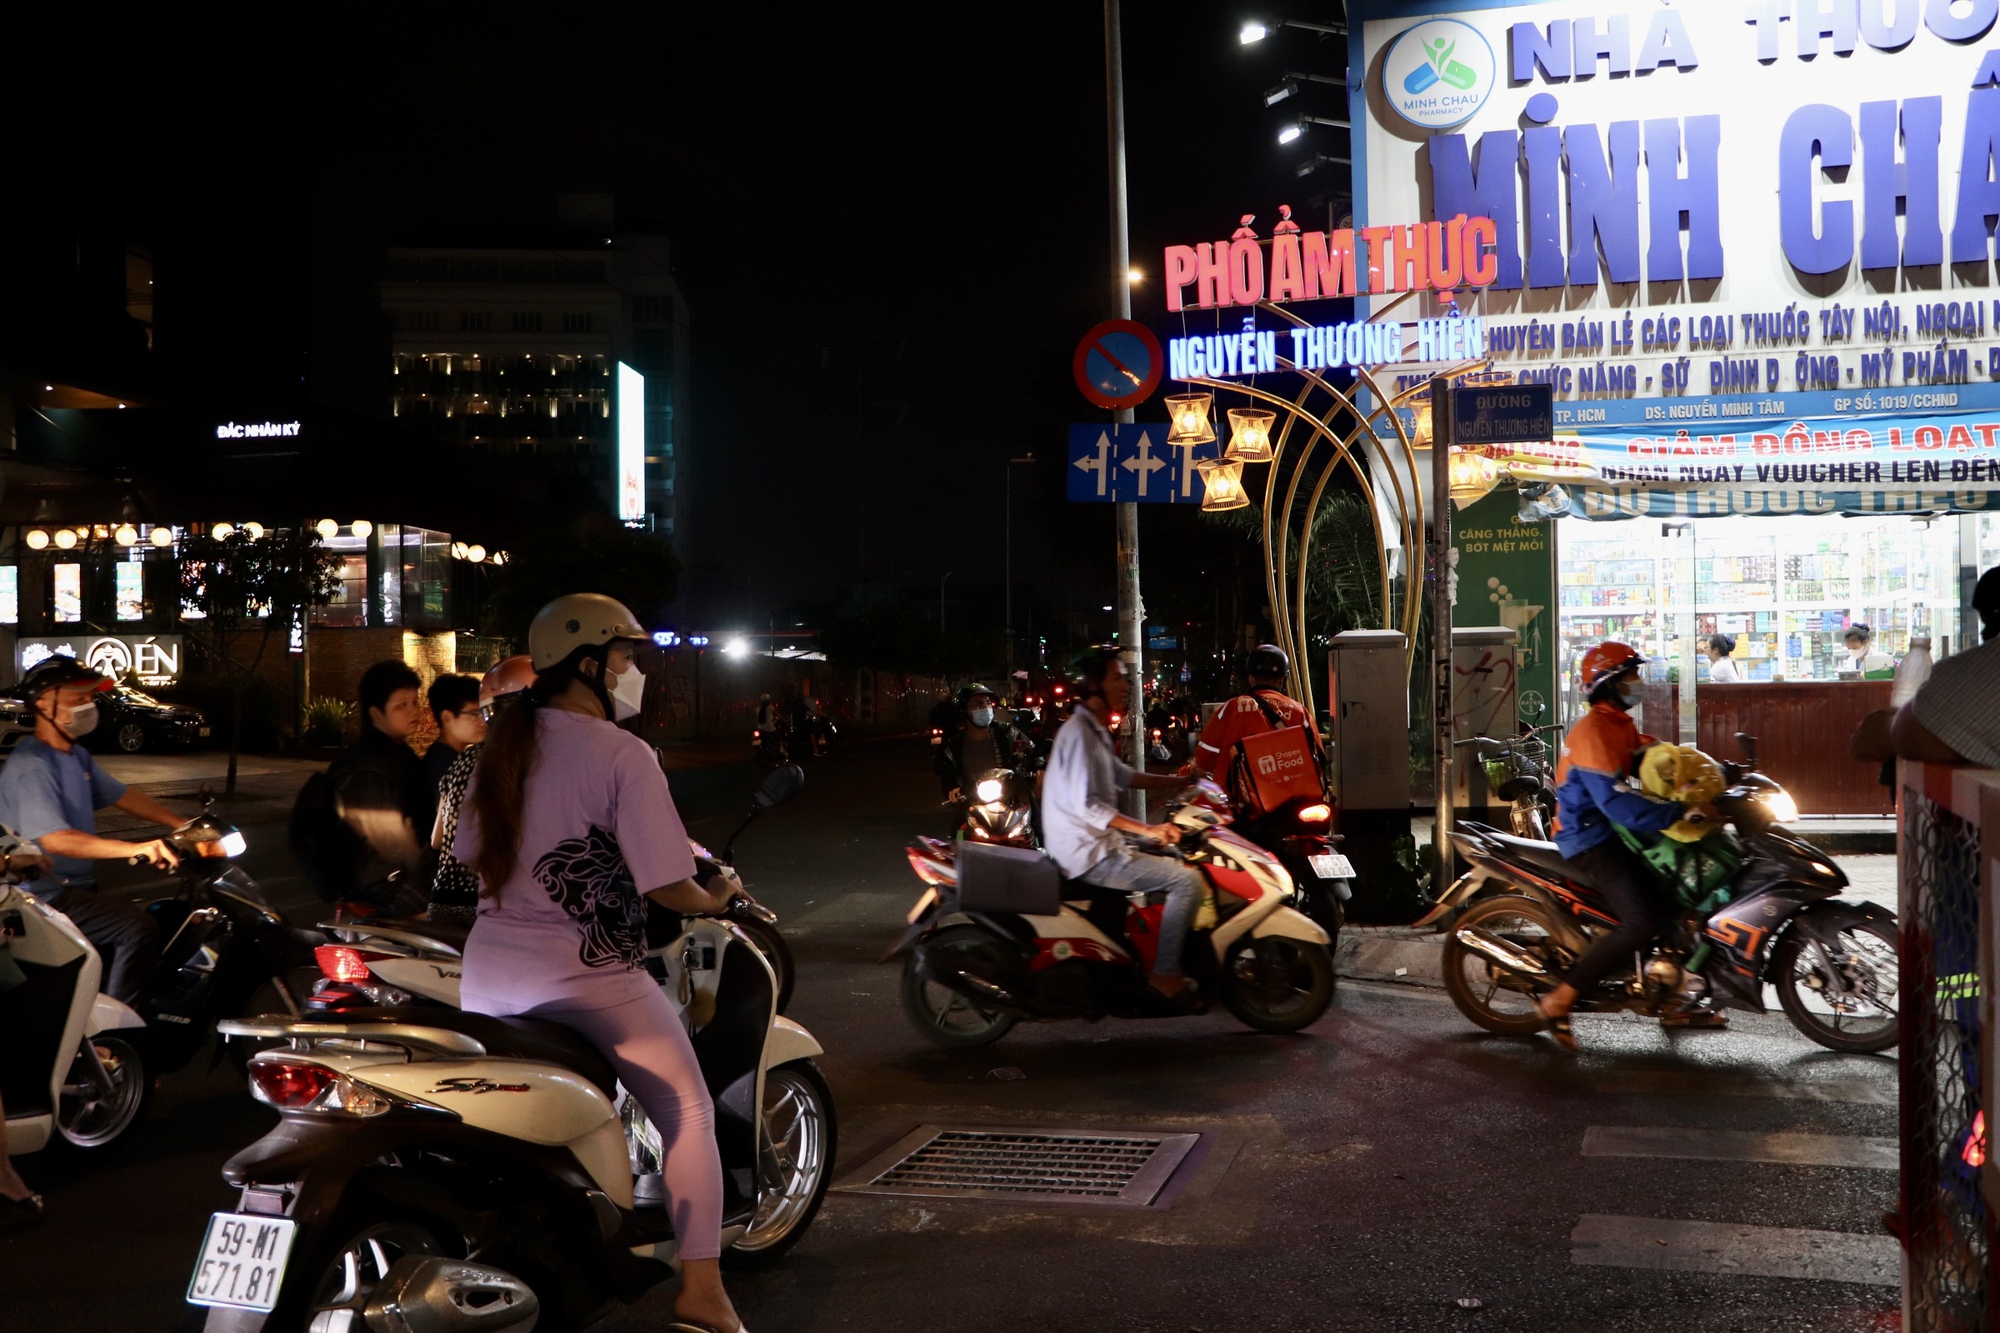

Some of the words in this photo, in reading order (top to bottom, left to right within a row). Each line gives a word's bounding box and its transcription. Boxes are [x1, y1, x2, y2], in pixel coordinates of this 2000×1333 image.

[1403, 97, 1442, 110] MINH
[1441, 94, 1478, 107] CHAU
[1419, 107, 1463, 117] PHARMACY
[1164, 213, 1263, 312] PHỐ
[1269, 203, 1358, 302] ẨM
[1361, 213, 1498, 304] THỰC
[1489, 318, 1556, 352] HUYÊN
[1562, 315, 1604, 349] BÁN
[1641, 312, 1682, 345] CÁC
[1688, 314, 1734, 348] LOẠI
[1741, 301, 1810, 341] THUỐC
[1820, 303, 1855, 337] TÂY
[1864, 300, 1908, 338] NỘI,
[1916, 300, 1984, 335] NGOẠI
[1169, 316, 1276, 380] NGUYỄN
[1290, 320, 1401, 378] THƯỢNG
[1579, 360, 1637, 392] NĂNG
[1861, 347, 1893, 380] MỸ
[1902, 337, 1968, 378] PHẨM
[1475, 393, 1532, 409] ĐƯỜNG
[1645, 406, 1666, 420] DS:
[1669, 399, 1717, 418] NGUYỄN
[1721, 402, 1754, 417] MINH
[1758, 400, 1785, 415] TÂM
[1834, 399, 1852, 412] GP
[1855, 391, 1877, 412] SỐ:
[1880, 392, 1959, 411] 1019/CCHND
[1458, 412, 1493, 438] NGUYỄN
[1556, 411, 1575, 423] TP.
[1577, 408, 1606, 422] HCM
[1627, 429, 1736, 460] GIẢM
[1751, 422, 1872, 457] ĐỒNG
[1889, 424, 2000, 452] LOẠT
[1680, 464, 1744, 482] NGAY
[1755, 459, 1881, 483] VOUCHER
[1492, 540, 1516, 553] MỆT
[1519, 538, 1544, 550] MỎI
[134, 637, 178, 674] ÉN
[1275, 748, 1301, 760] Shopee
[1277, 756, 1304, 770] Food
[217, 1221, 281, 1261] 59-M1
[197, 1259, 277, 1304] 571.81
